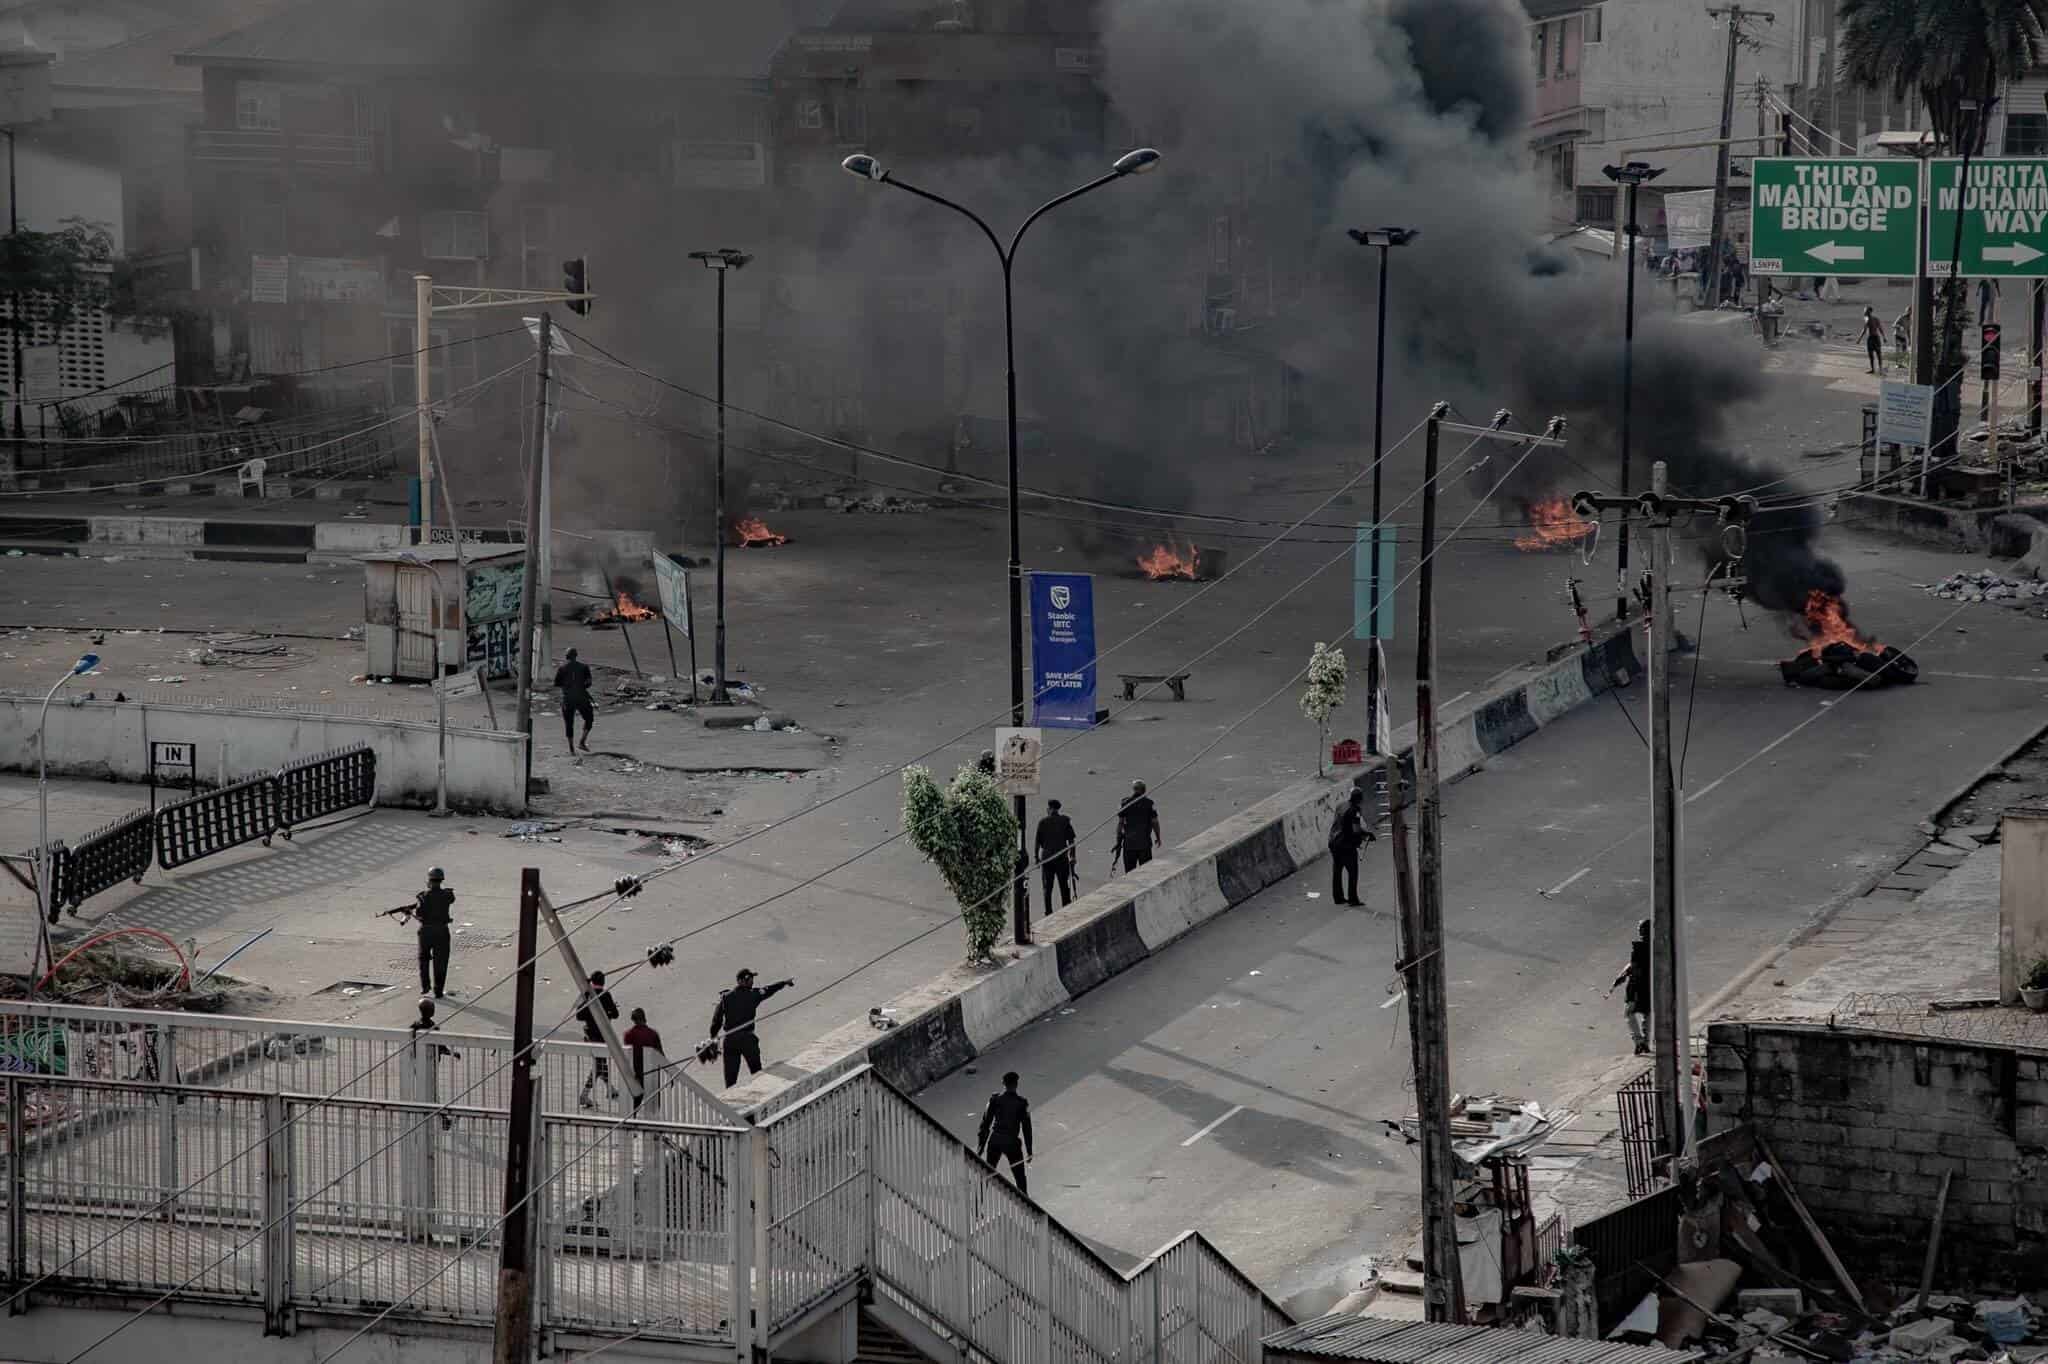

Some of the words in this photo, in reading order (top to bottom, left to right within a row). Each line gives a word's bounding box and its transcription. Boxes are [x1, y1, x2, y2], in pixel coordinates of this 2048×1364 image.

[1795, 165, 1878, 186] THIRD
[1759, 184, 1912, 208] MAINLAND
[1781, 207, 1887, 231] BRIDGE
[1984, 210, 2047, 233] WAY
[1047, 611, 1075, 620] Stanbic
[1045, 671, 1062, 680] SAVE
[1063, 672, 1082, 681] MORE
[1046, 680, 1061, 688] FOR
[1061, 680, 1082, 689] LATER
[165, 747, 181, 760] IN
